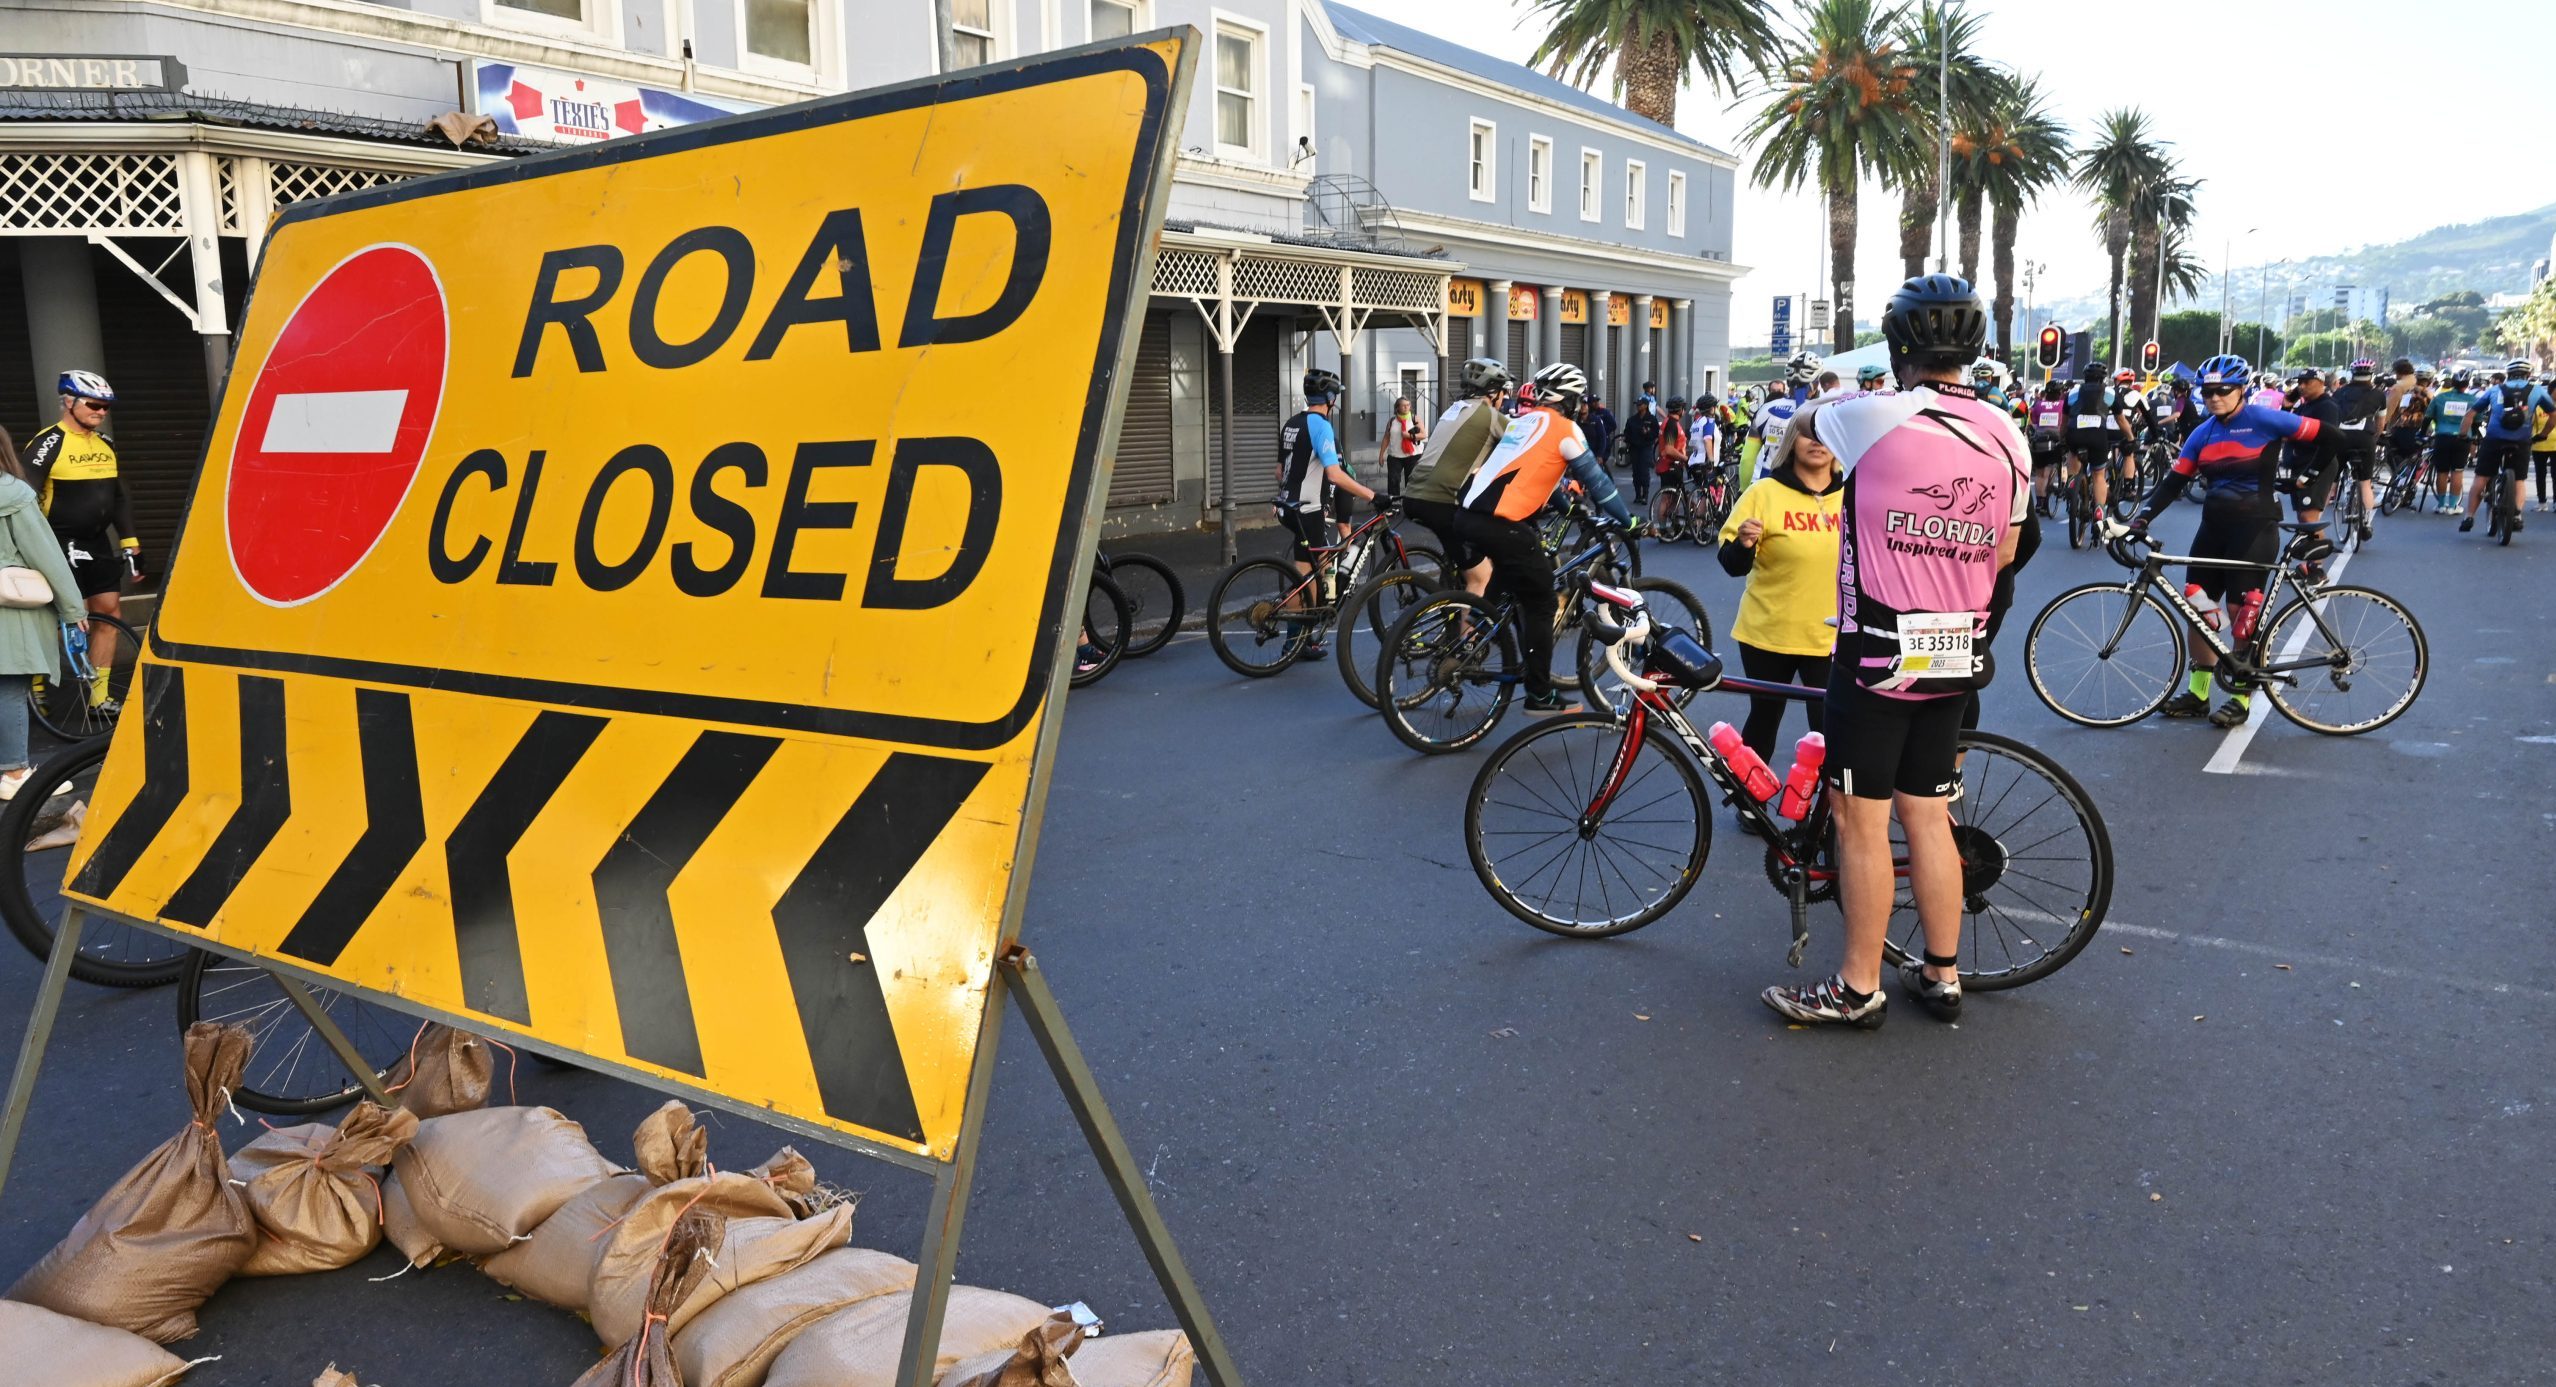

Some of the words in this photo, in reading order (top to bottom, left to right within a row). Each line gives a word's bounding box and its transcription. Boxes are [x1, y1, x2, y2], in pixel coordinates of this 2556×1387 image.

[0, 58, 143, 88] ORNER
[511, 184, 1052, 379] ROAD
[1449, 284, 1476, 312] asty
[1561, 293, 1580, 318] asty
[1777, 300, 1787, 311] P
[1939, 383, 1976, 398] FLORIDA
[32, 431, 61, 467] RAWSON
[69, 452, 113, 465] RAWSON
[428, 435, 1003, 610] CLOSED
[1783, 510, 1821, 532] ASK
[1823, 512, 1840, 532] M
[1886, 509, 1997, 549] FLORIDA
[1886, 537, 1958, 560] Inspired
[1973, 548, 1990, 563] life
[2156, 575, 2231, 655] cannondale
[1908, 637, 1924, 651] 3E
[1928, 634, 1970, 652] 35318
